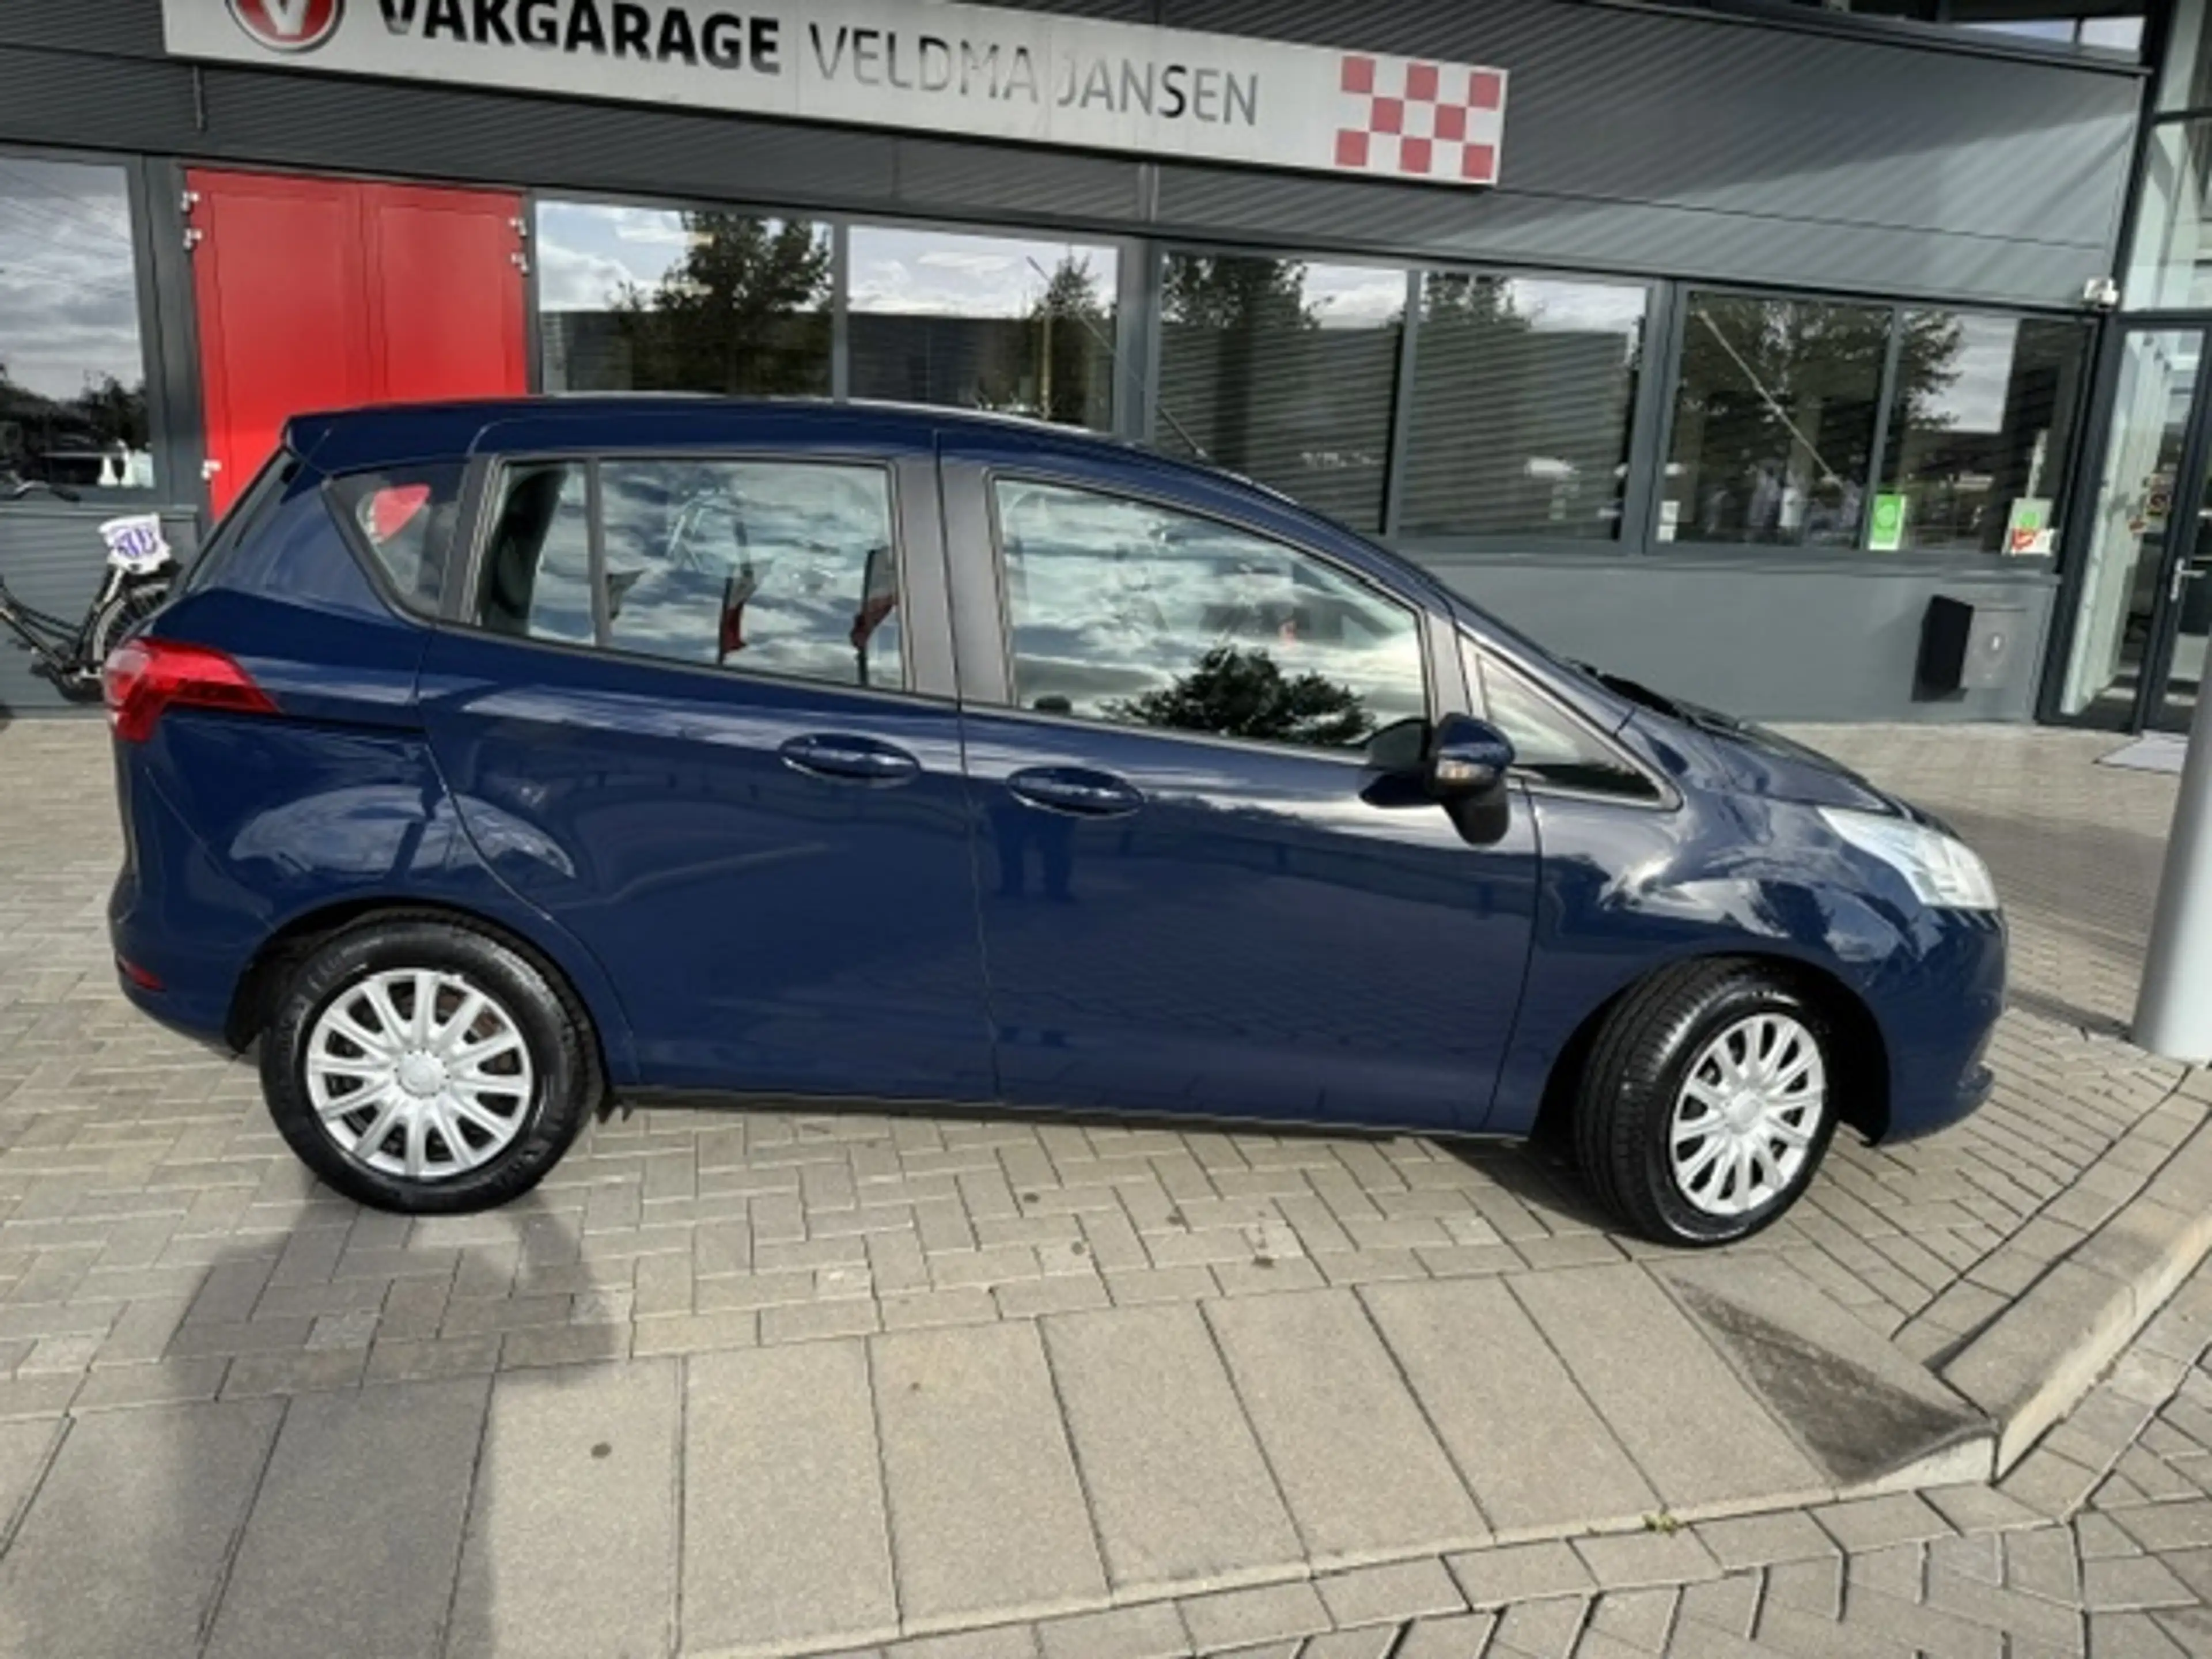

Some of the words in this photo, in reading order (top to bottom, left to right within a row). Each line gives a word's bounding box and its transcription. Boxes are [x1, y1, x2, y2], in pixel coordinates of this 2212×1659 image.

[378, 0, 781, 74] VAKGARAGE
[809, 22, 1037, 103] VELDMA
[1057, 58, 1258, 126] JANSEN
